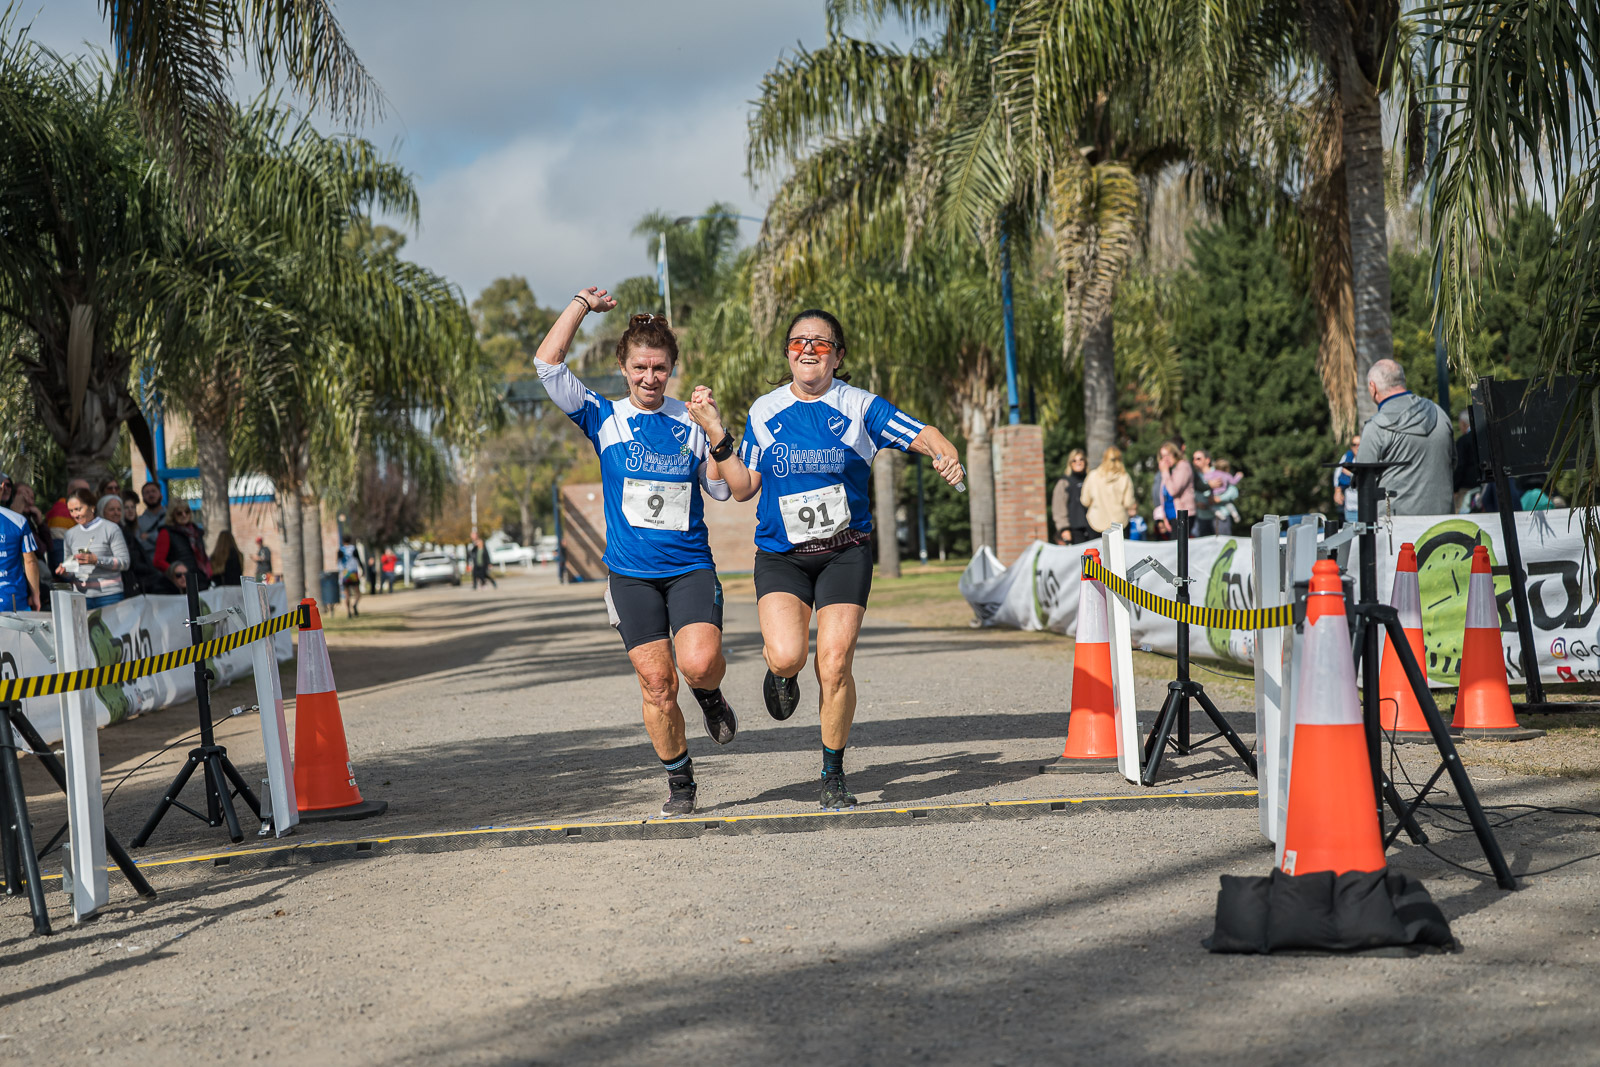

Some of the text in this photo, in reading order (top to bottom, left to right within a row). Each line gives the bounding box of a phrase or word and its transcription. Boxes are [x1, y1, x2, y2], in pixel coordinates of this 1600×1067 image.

[626, 442, 644, 472] 3
[772, 442, 788, 478] 3
[790, 446, 844, 464] MARATÓN
[648, 494, 664, 518] 9
[798, 502, 834, 530] 91
